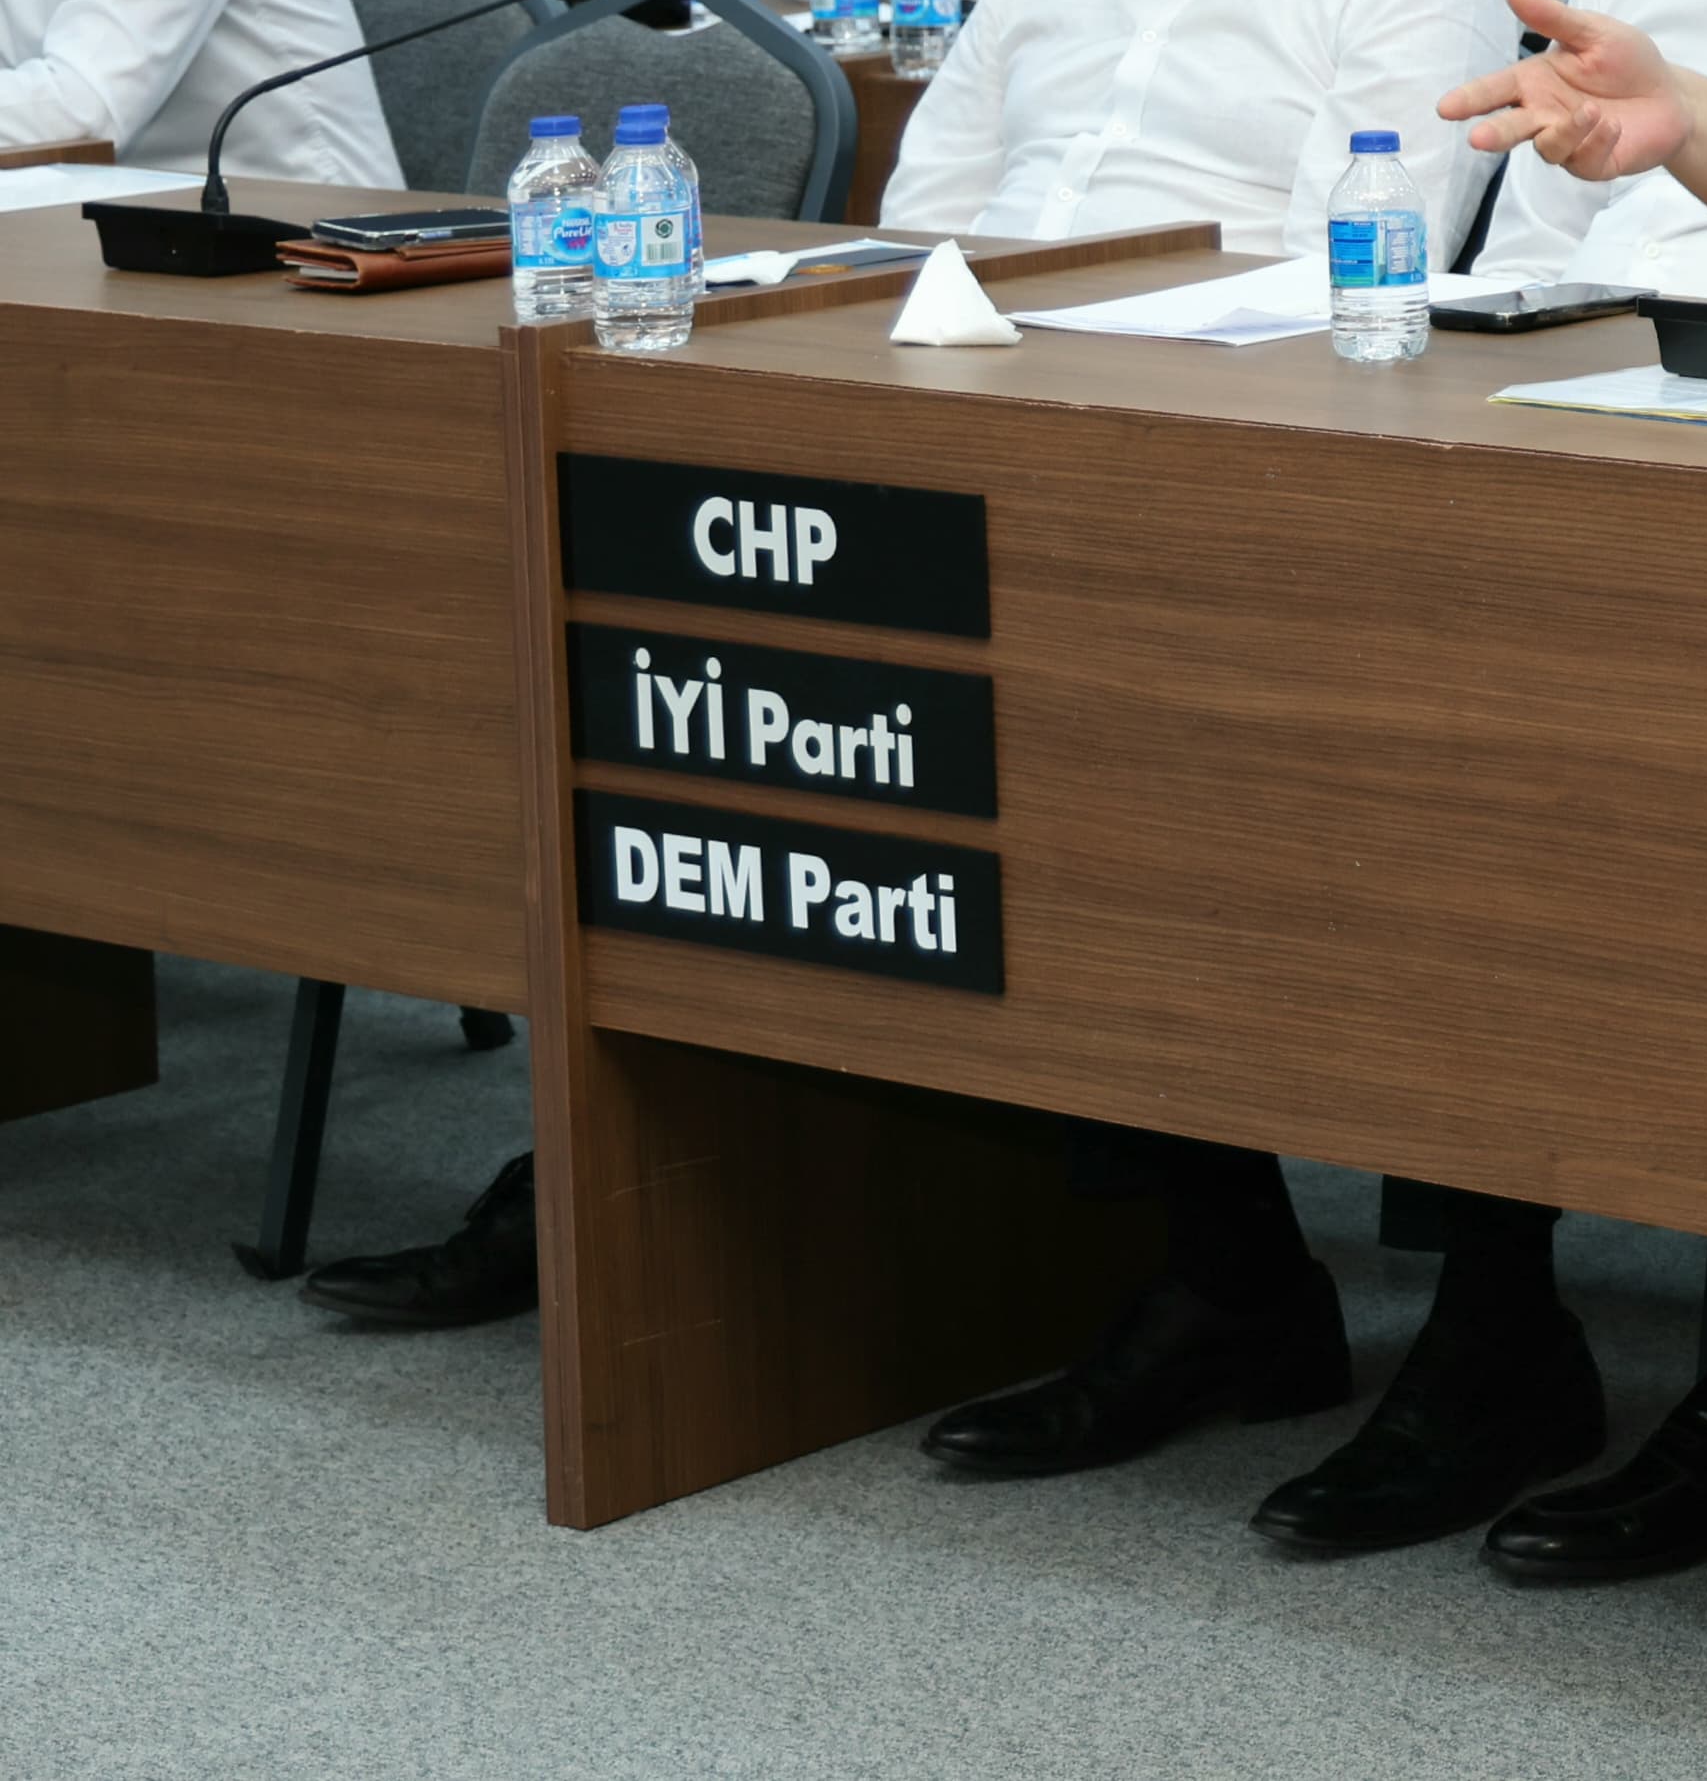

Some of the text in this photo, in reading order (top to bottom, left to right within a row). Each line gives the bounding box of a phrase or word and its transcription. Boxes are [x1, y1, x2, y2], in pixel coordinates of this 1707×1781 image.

[694, 496, 837, 585] CHP
[635, 647, 914, 788] İYİ Parti
[614, 826, 957, 953] DEM Parti
